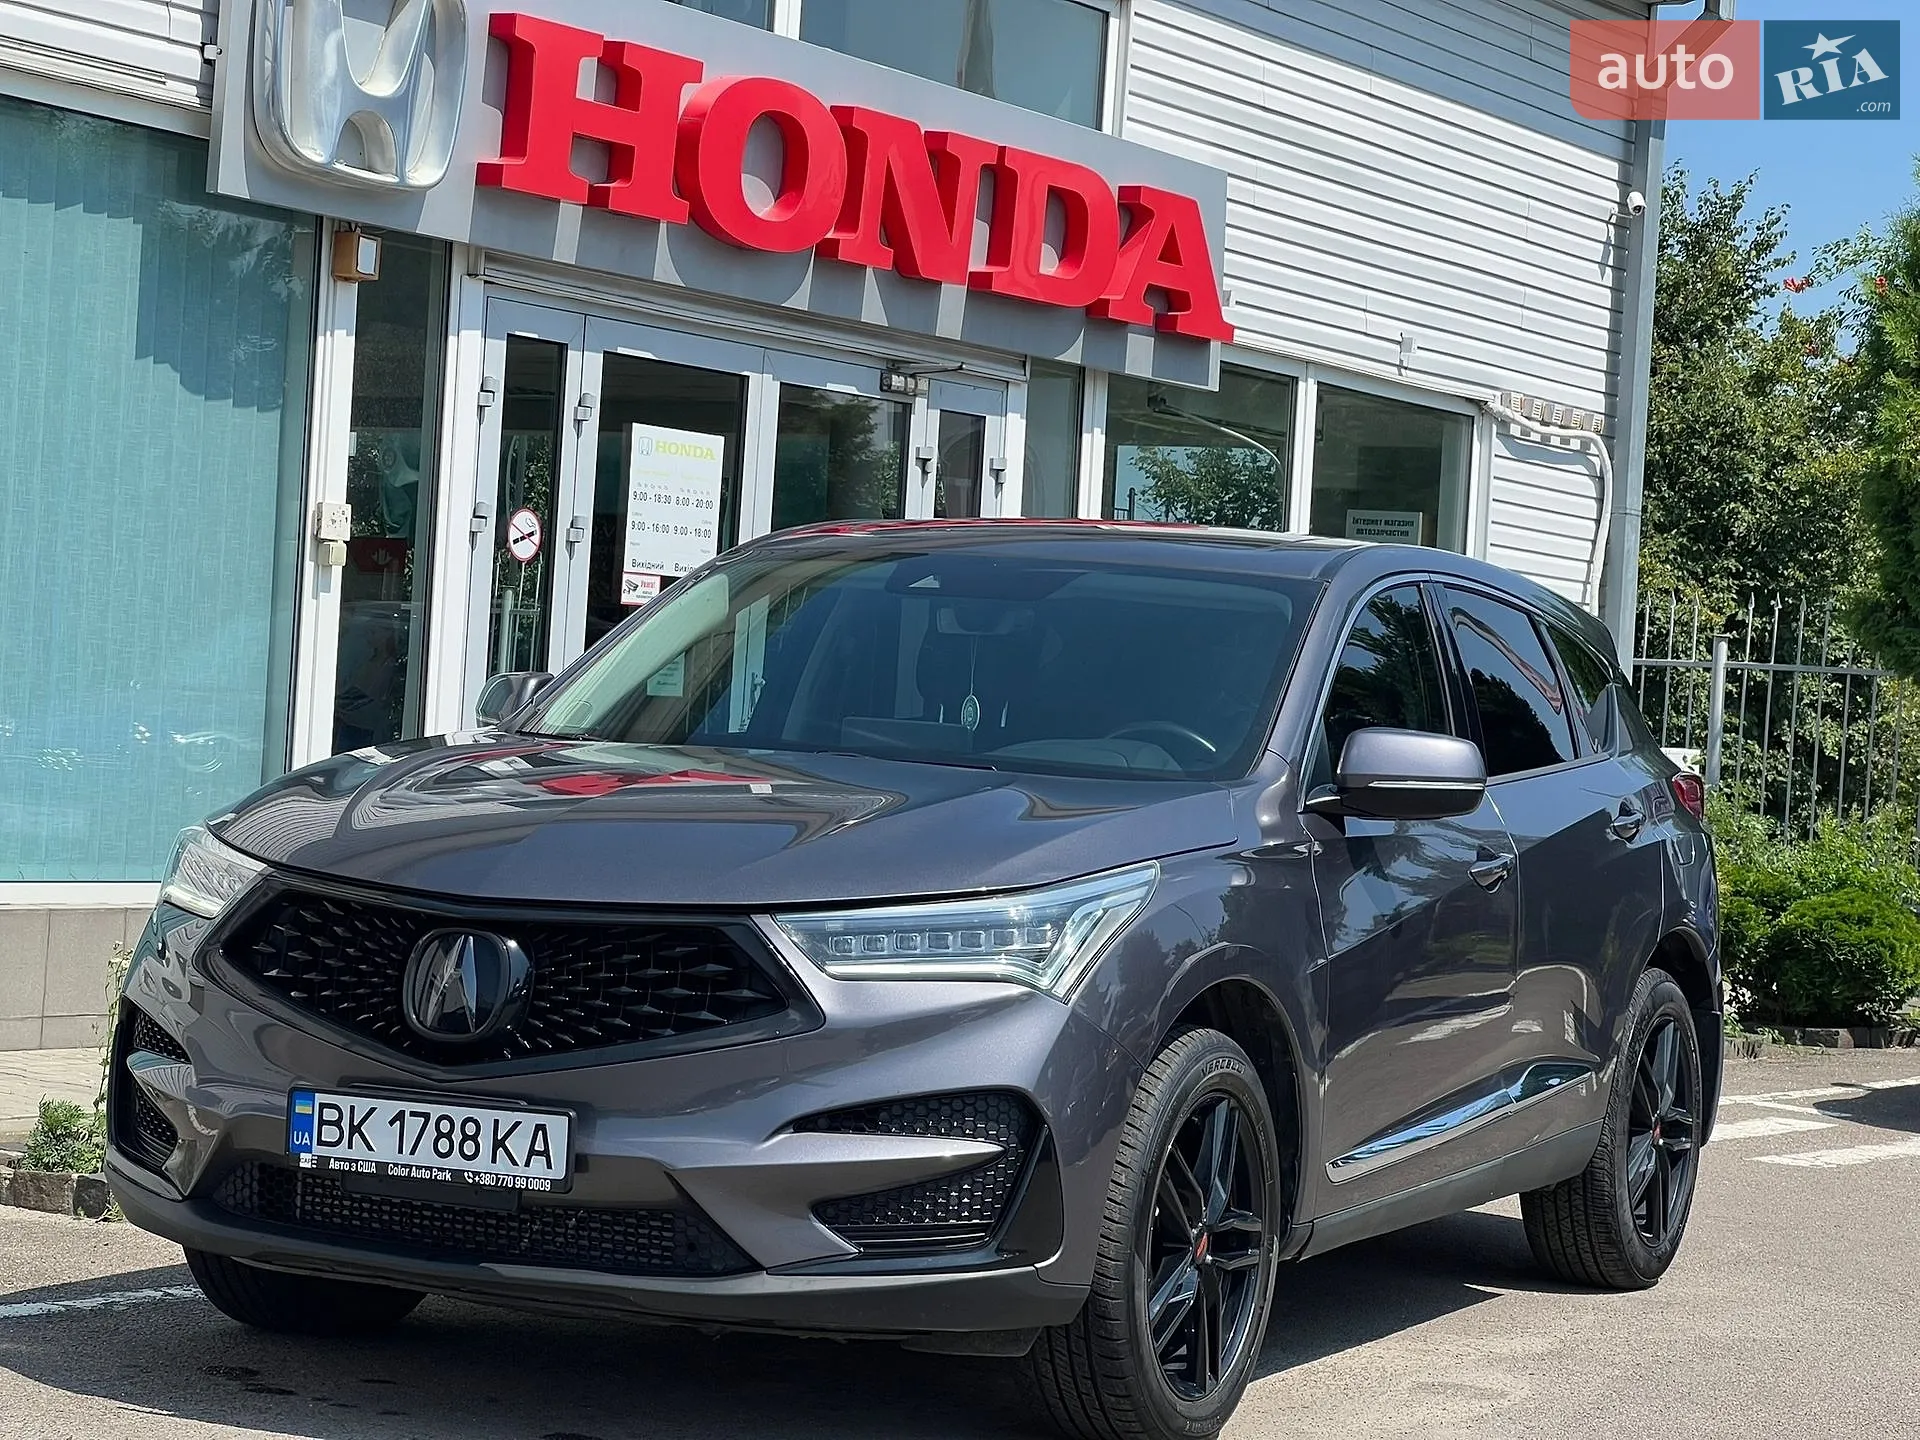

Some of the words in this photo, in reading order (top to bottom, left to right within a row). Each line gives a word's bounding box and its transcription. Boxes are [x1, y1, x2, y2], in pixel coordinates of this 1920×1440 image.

[476, 13, 1234, 342] HONDA
[655, 440, 716, 461] HONDA
[633, 490, 648, 502] 9:00
[631, 558, 665, 570] Вихідний
[293, 1131, 311, 1146] UA
[316, 1102, 378, 1152] BK
[388, 1109, 482, 1162] 1788
[490, 1118, 554, 1170] KA
[328, 1158, 350, 1171] Авто
[357, 1160, 377, 1174] США
[387, 1163, 409, 1177] Color
[410, 1168, 431, 1180] Auto
[431, 1169, 452, 1182] Park
[474, 1173, 496, 1186] +380
[497, 1175, 514, 1188] 770
[515, 1177, 527, 1189] 99
[527, 1178, 551, 1192] 0009
